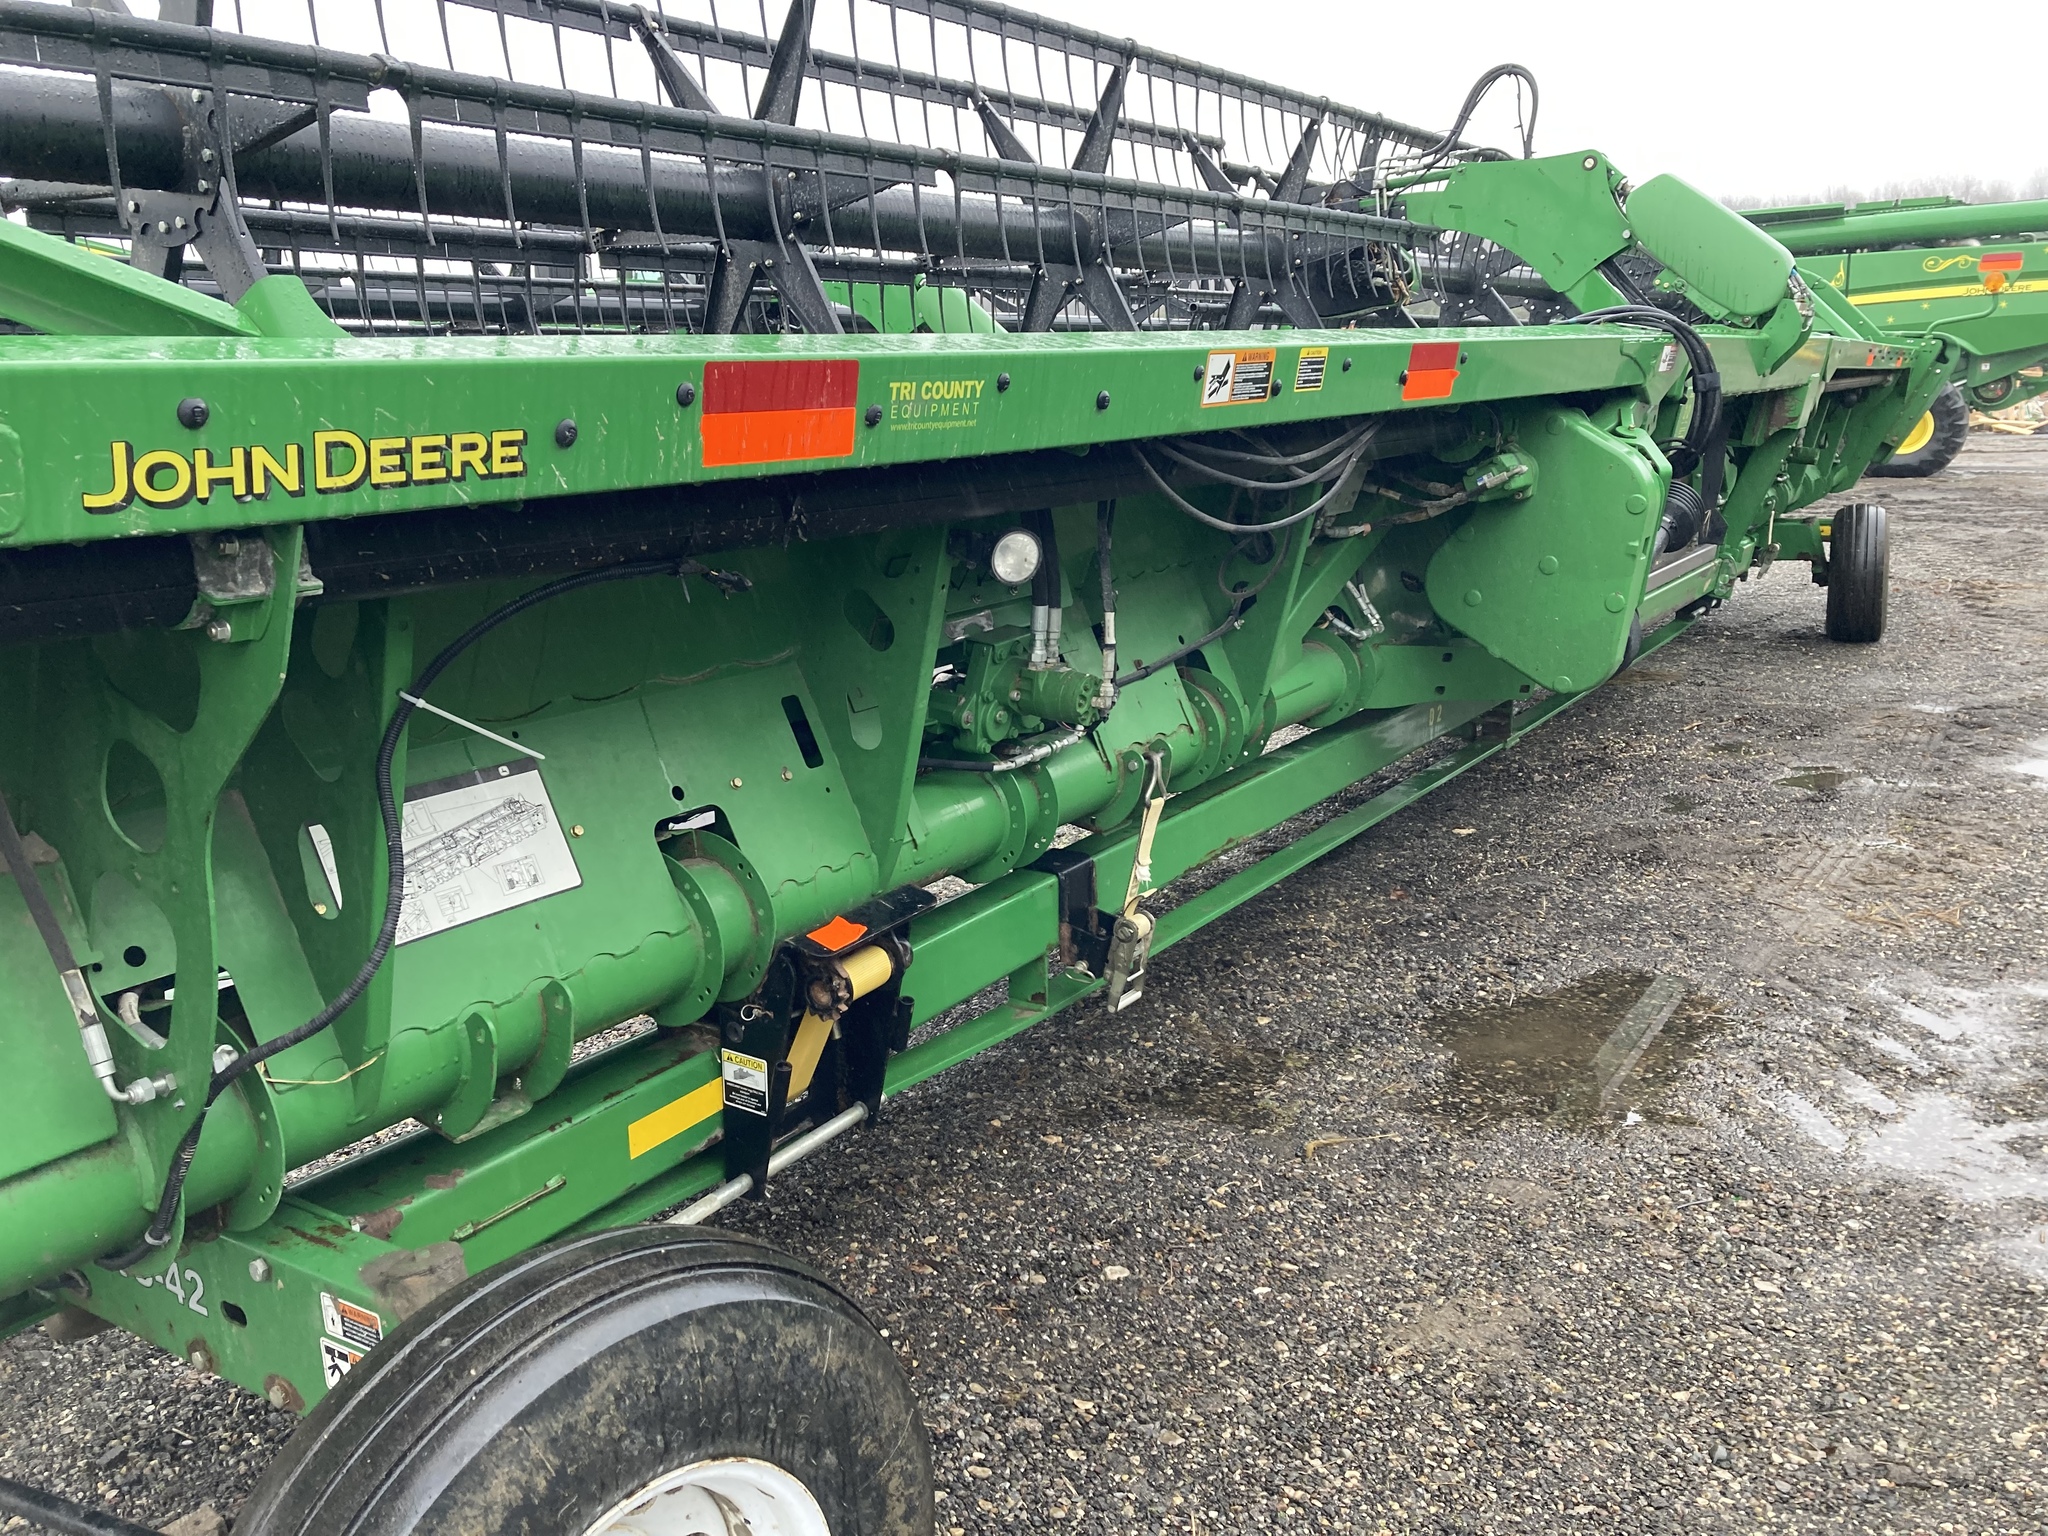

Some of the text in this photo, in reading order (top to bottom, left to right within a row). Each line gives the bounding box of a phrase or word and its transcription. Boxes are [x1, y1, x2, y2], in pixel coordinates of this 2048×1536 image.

[889, 380, 985, 401] TRI COUNTY
[890, 402, 980, 419] EQUIPMENT
[890, 419, 977, 431] www.tricountyequipment.net
[82, 428, 528, 515] JOHN DEERE
[734, 1055, 763, 1071] CAUTION
